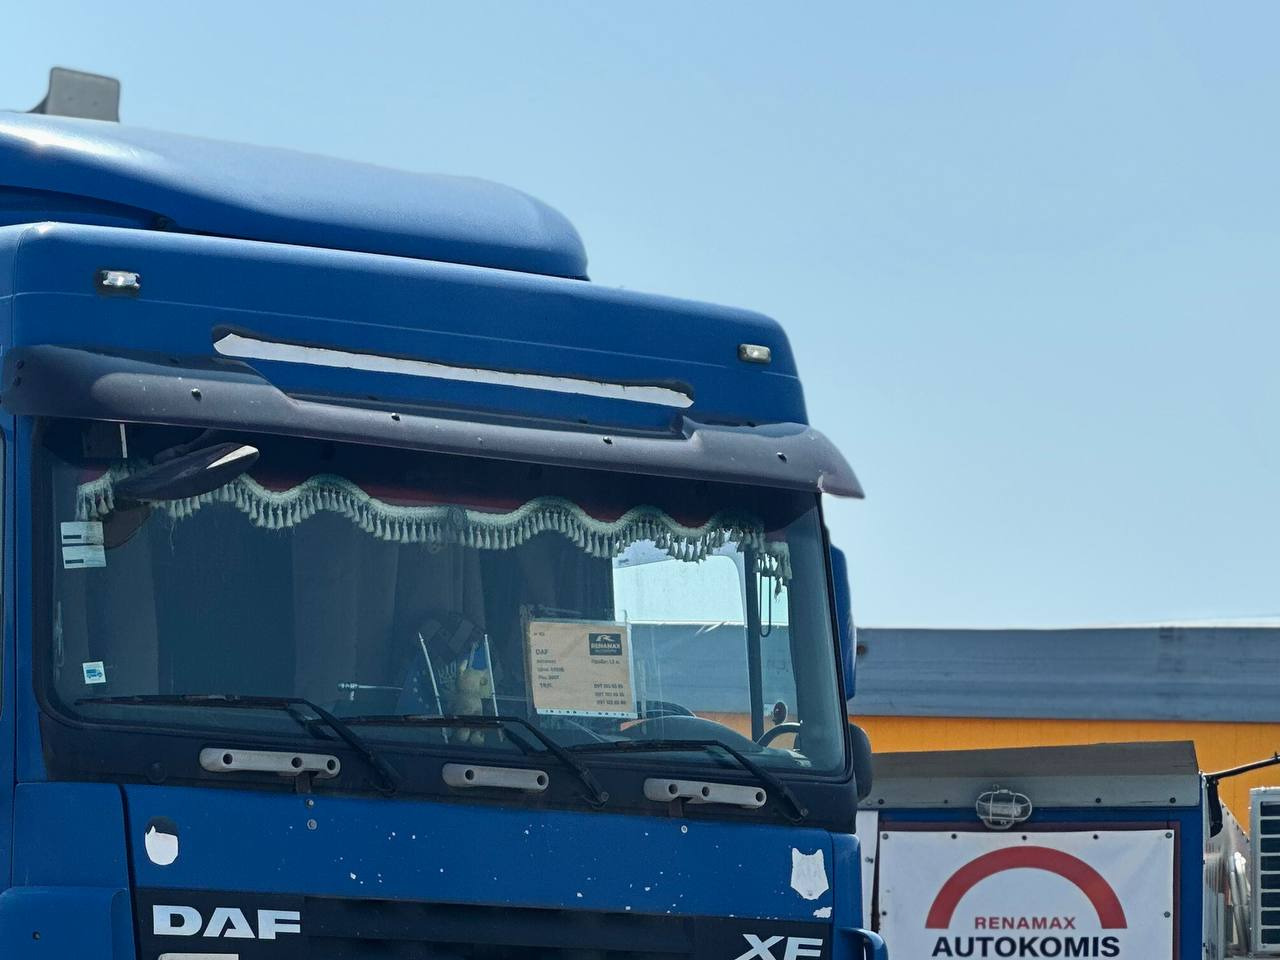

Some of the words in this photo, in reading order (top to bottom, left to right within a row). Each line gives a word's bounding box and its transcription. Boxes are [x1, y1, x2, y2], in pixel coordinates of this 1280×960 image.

[152, 904, 301, 940] DAF
[974, 916, 1076, 930] RENAMAX
[931, 936, 1121, 958] AUTOKOMIS
